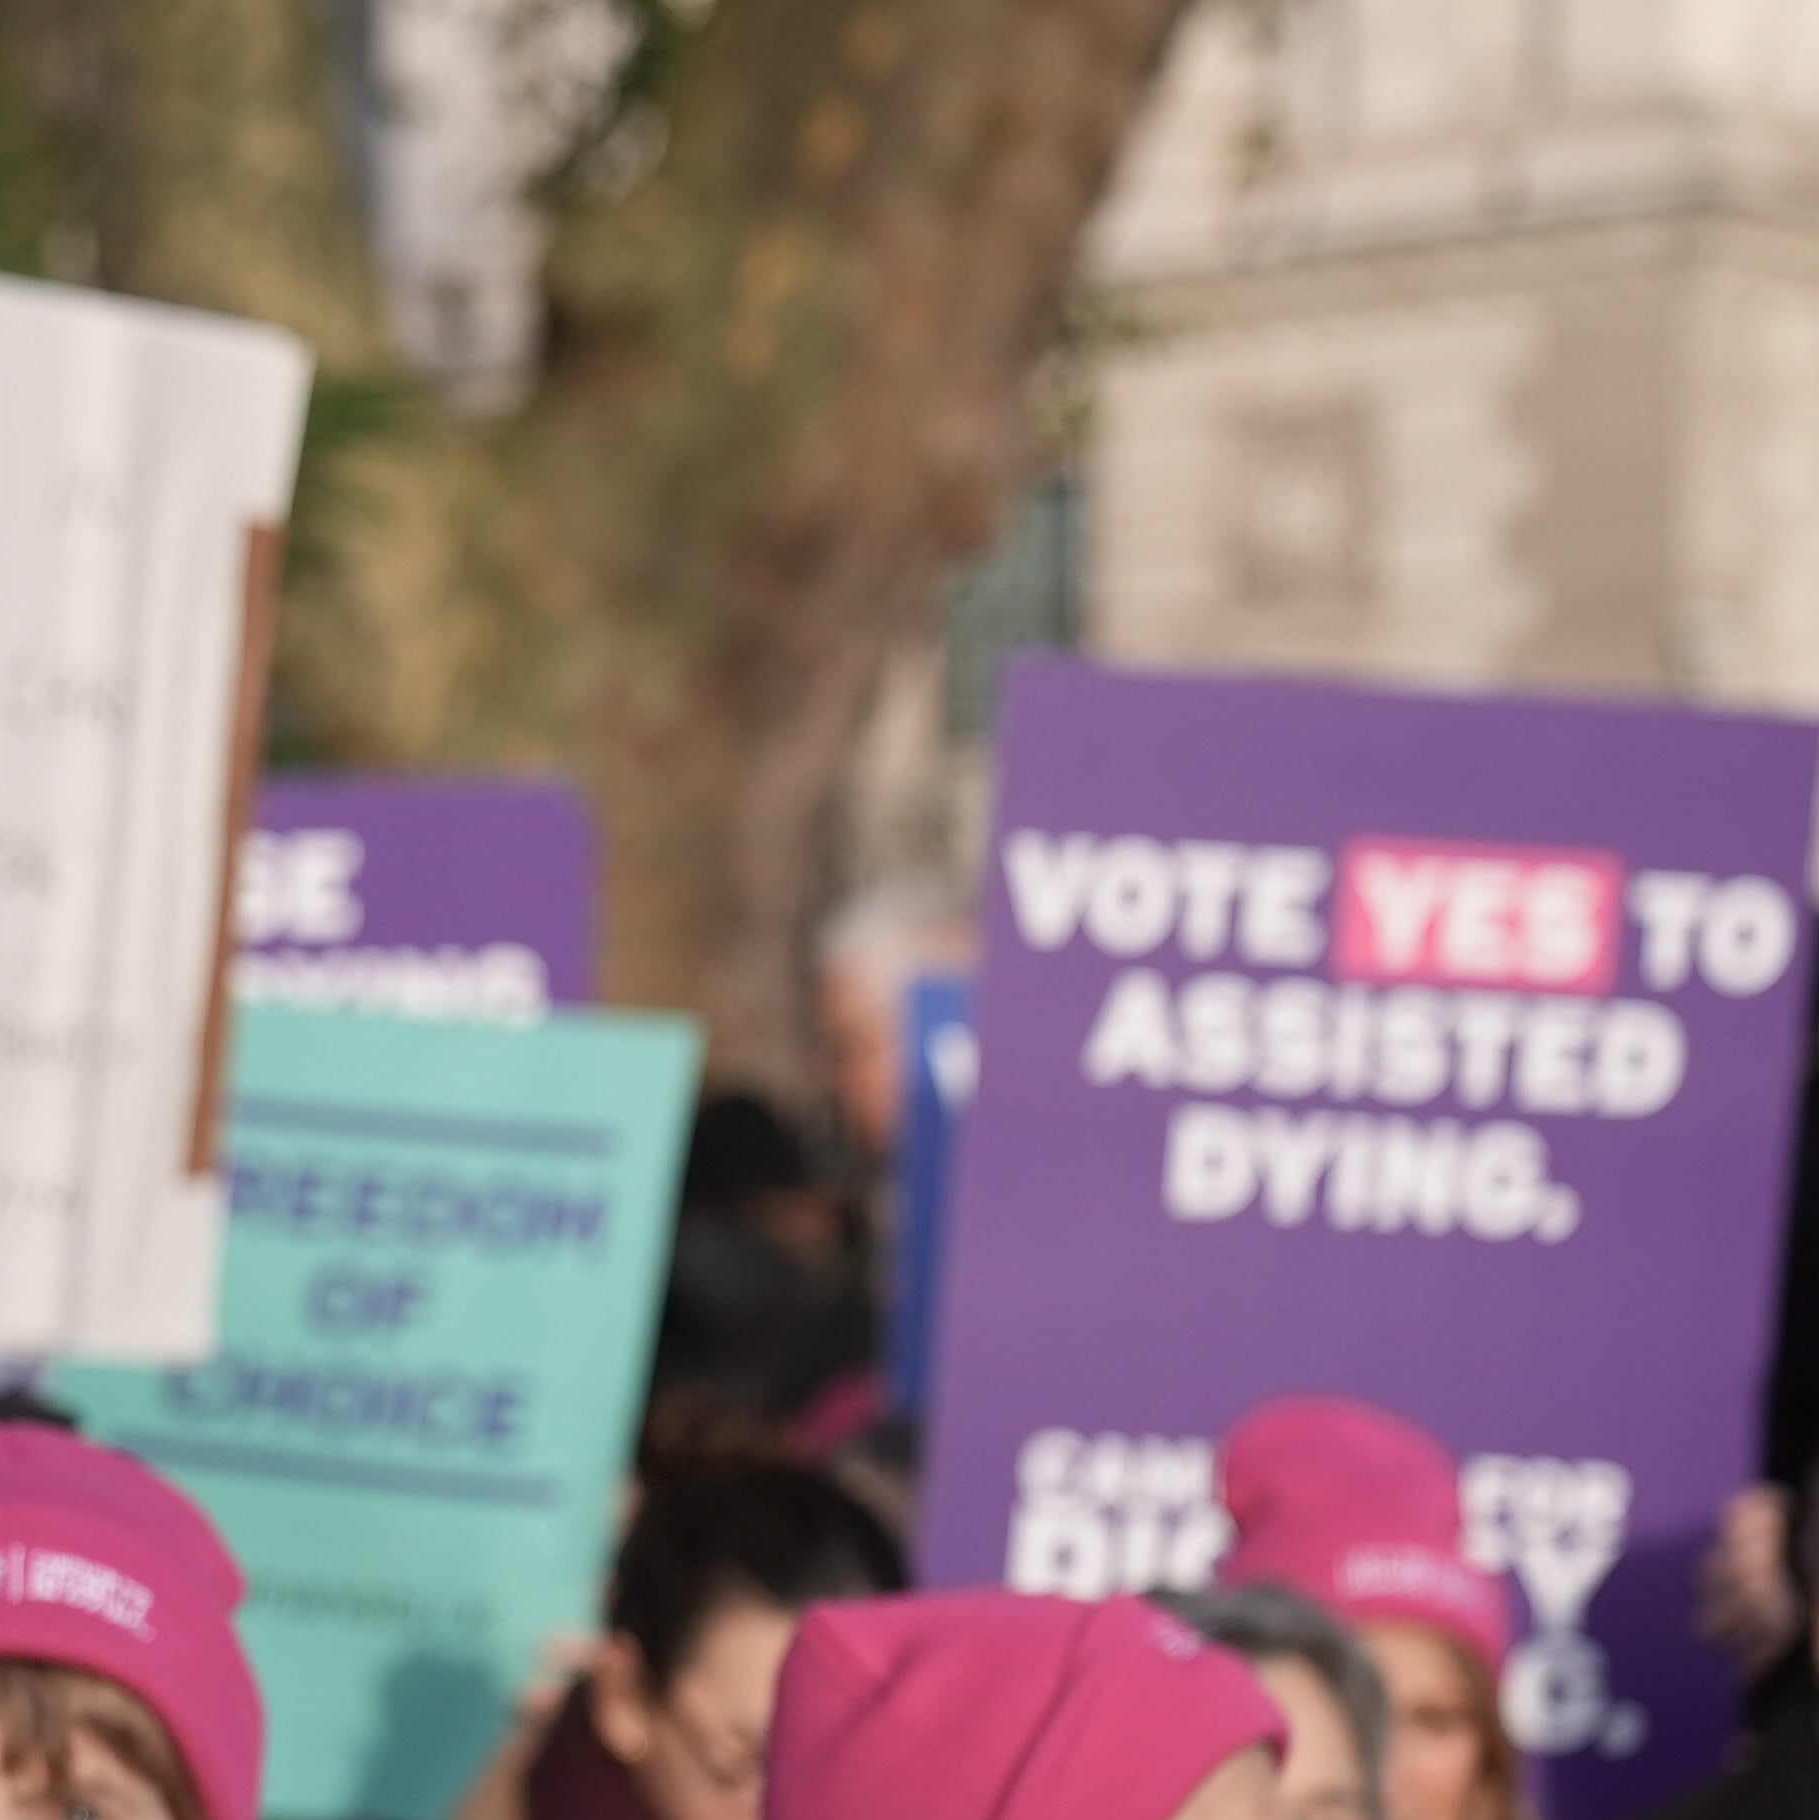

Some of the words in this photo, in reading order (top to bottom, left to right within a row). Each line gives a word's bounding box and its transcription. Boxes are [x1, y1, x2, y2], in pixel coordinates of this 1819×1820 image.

[1003, 830, 1333, 962] VOTE
[1348, 850, 1603, 985] YES
[1628, 868, 1795, 998] TO
[1081, 965, 1688, 1120] ASSISTED
[1163, 1100, 1583, 1246] DYING.
